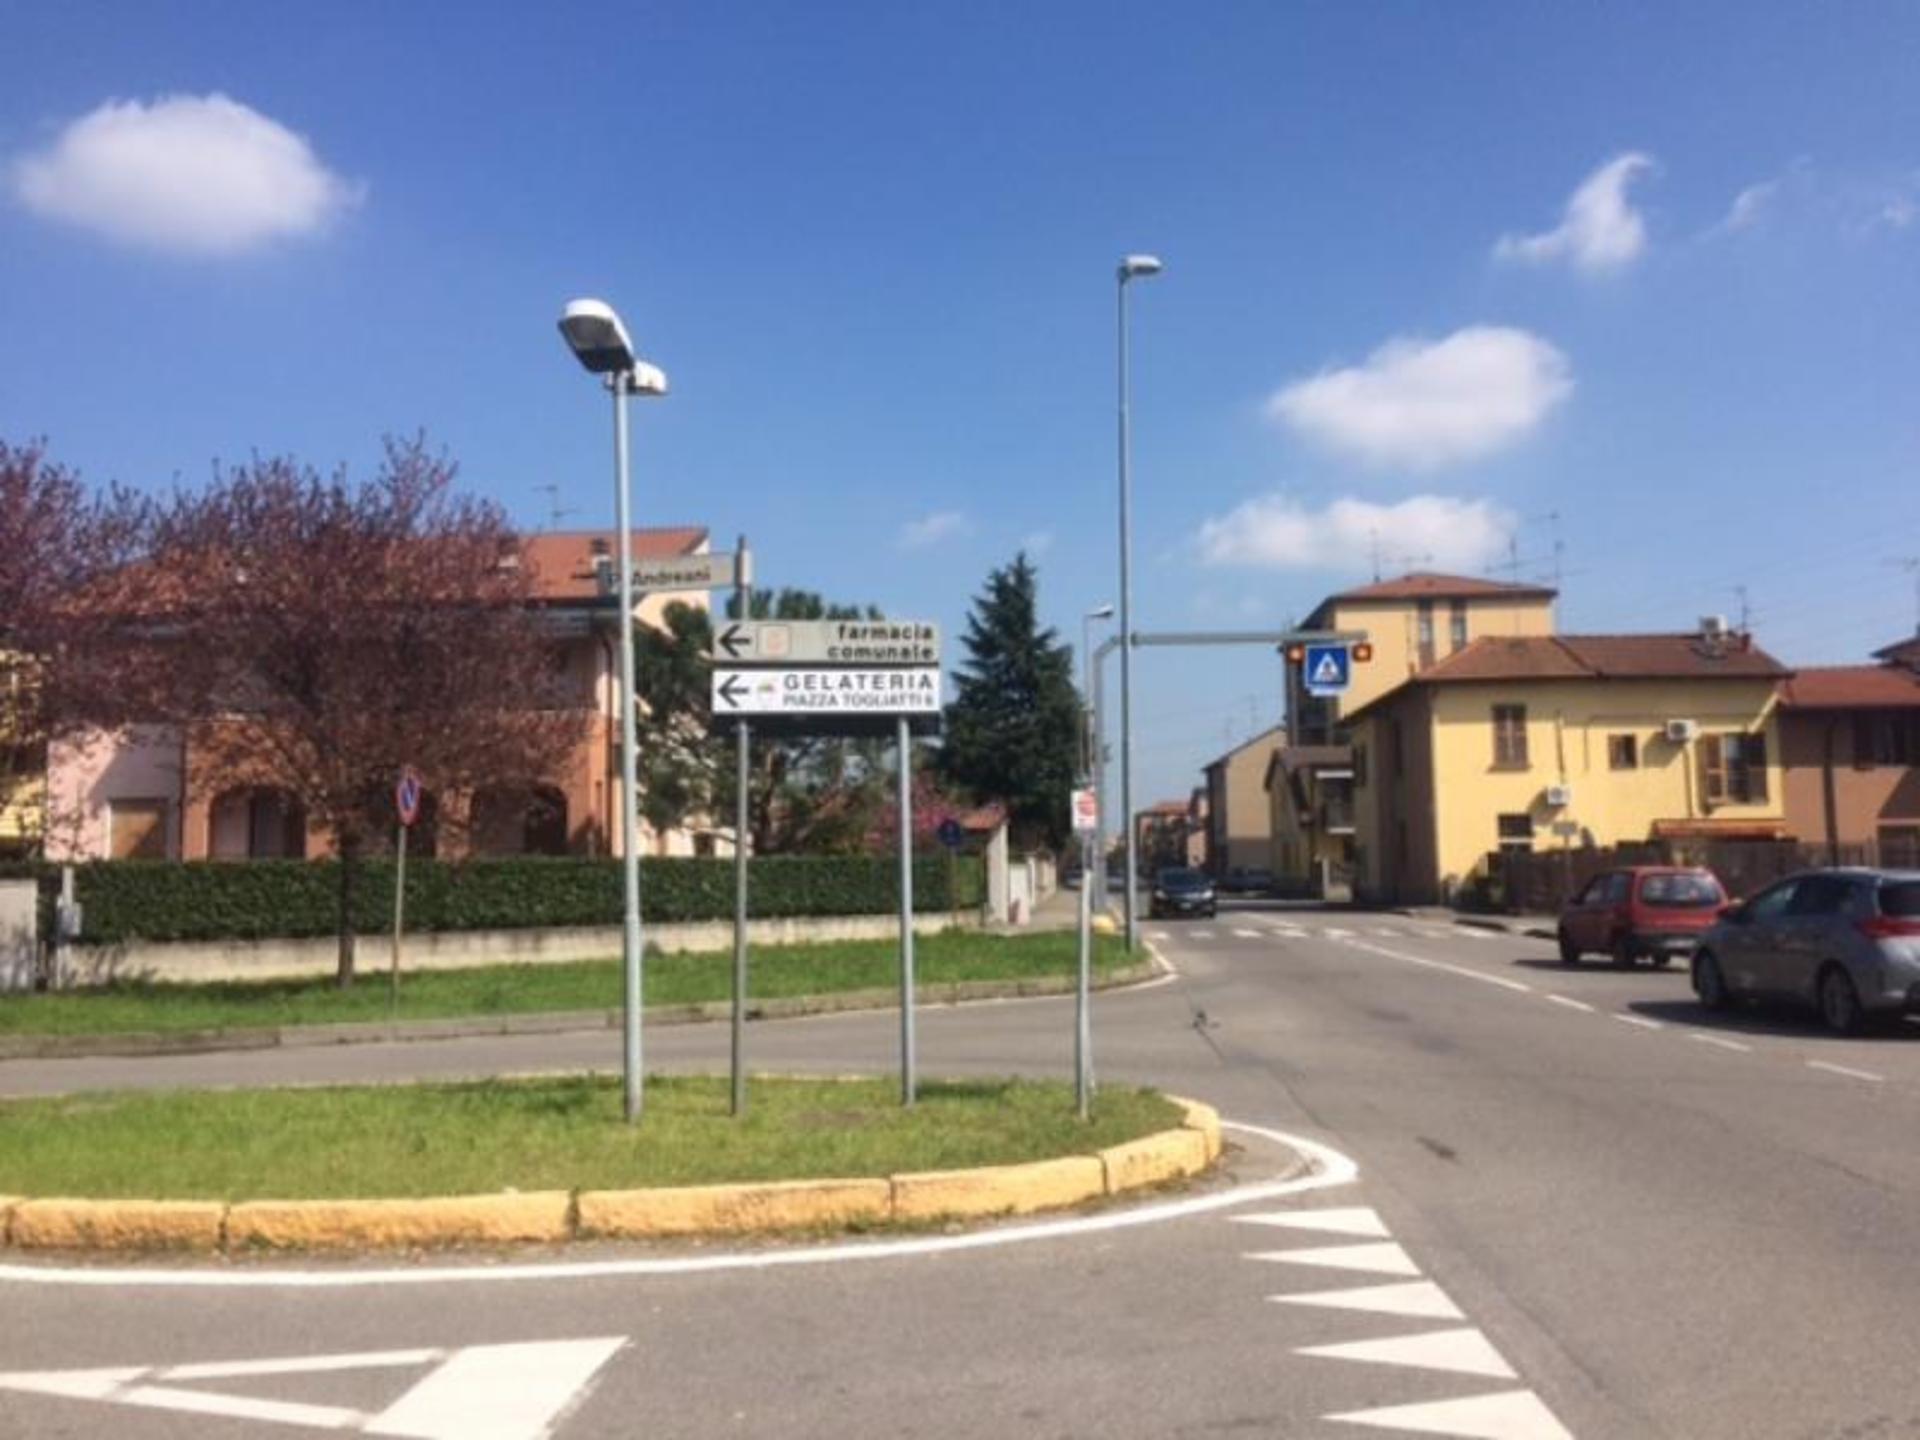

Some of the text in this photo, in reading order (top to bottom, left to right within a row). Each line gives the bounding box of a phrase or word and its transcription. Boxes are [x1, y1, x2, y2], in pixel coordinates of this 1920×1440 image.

[838, 624, 933, 640] farmacia
[827, 643, 933, 659] comunale
[783, 674, 933, 690] GELATERIA
[783, 693, 839, 707] PIAZZA
